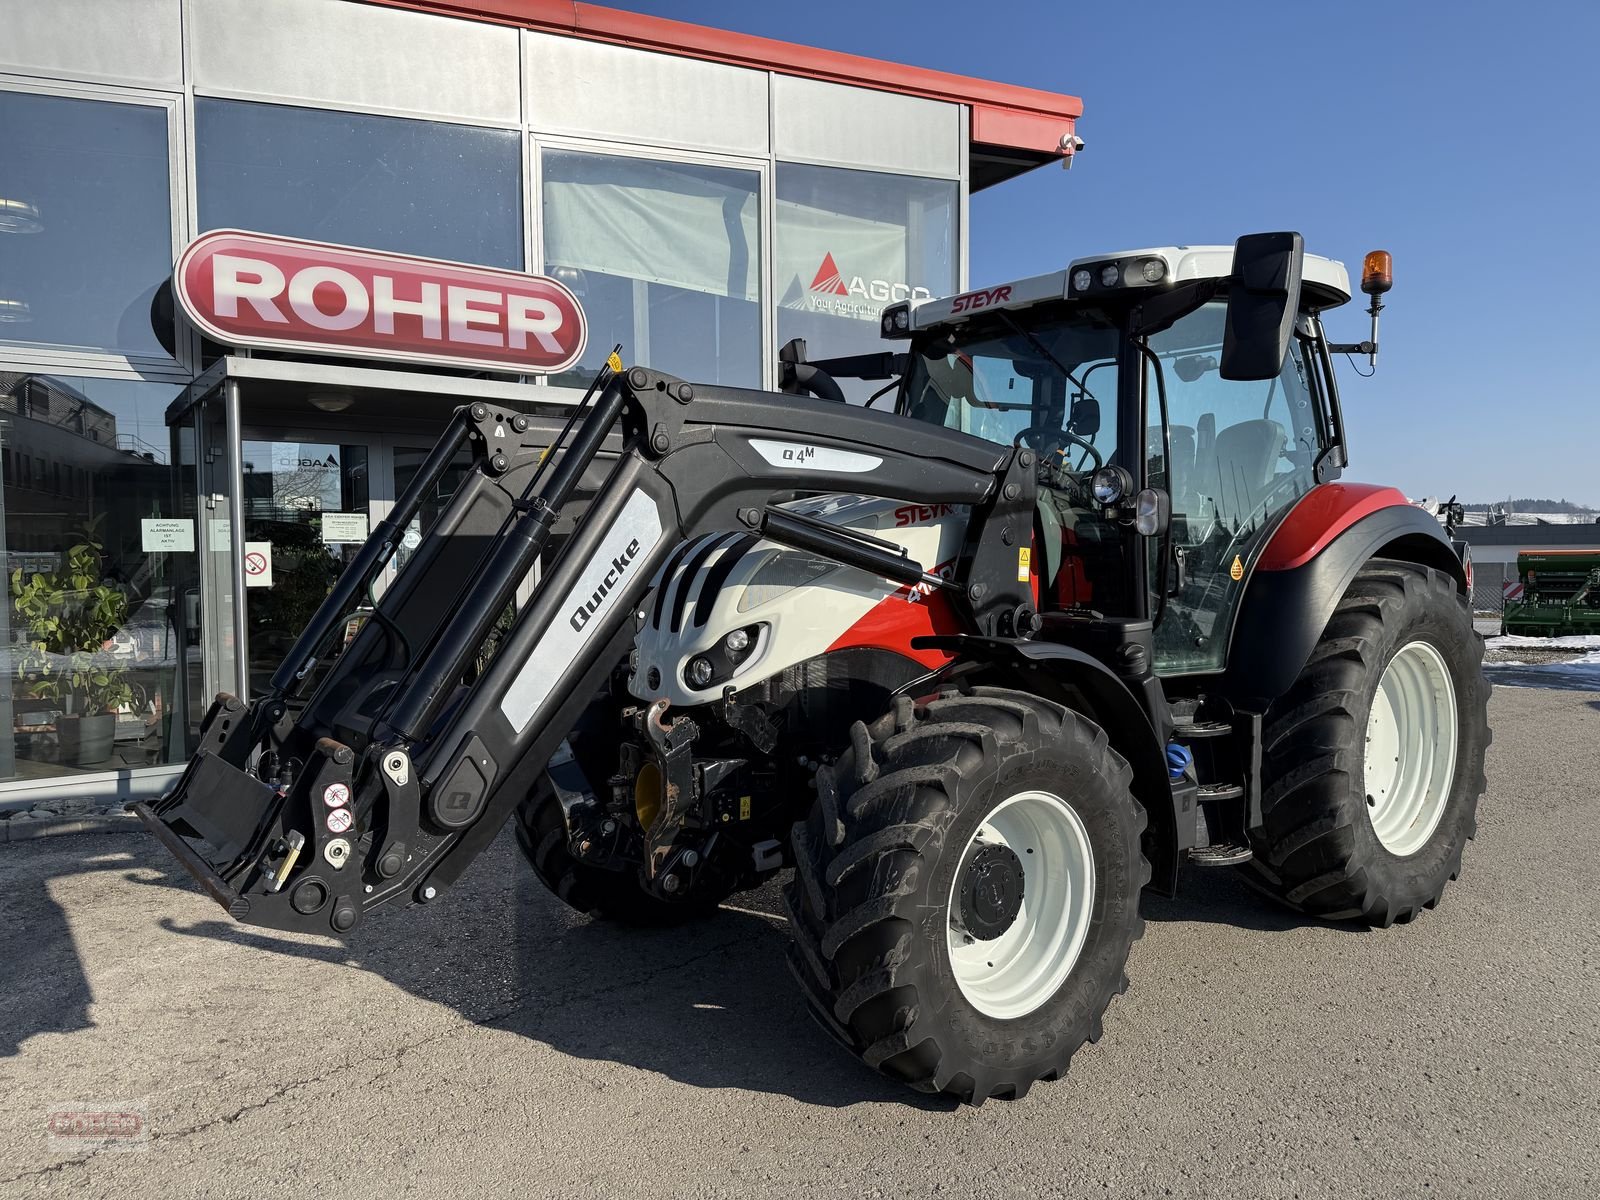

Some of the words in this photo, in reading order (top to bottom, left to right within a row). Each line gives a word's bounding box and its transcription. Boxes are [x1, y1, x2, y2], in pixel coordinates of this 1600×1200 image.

[212, 253, 566, 355] ROHER
[811, 295, 832, 310] Your
[950, 285, 1012, 314] STEYR
[569, 537, 641, 633] Quicke
